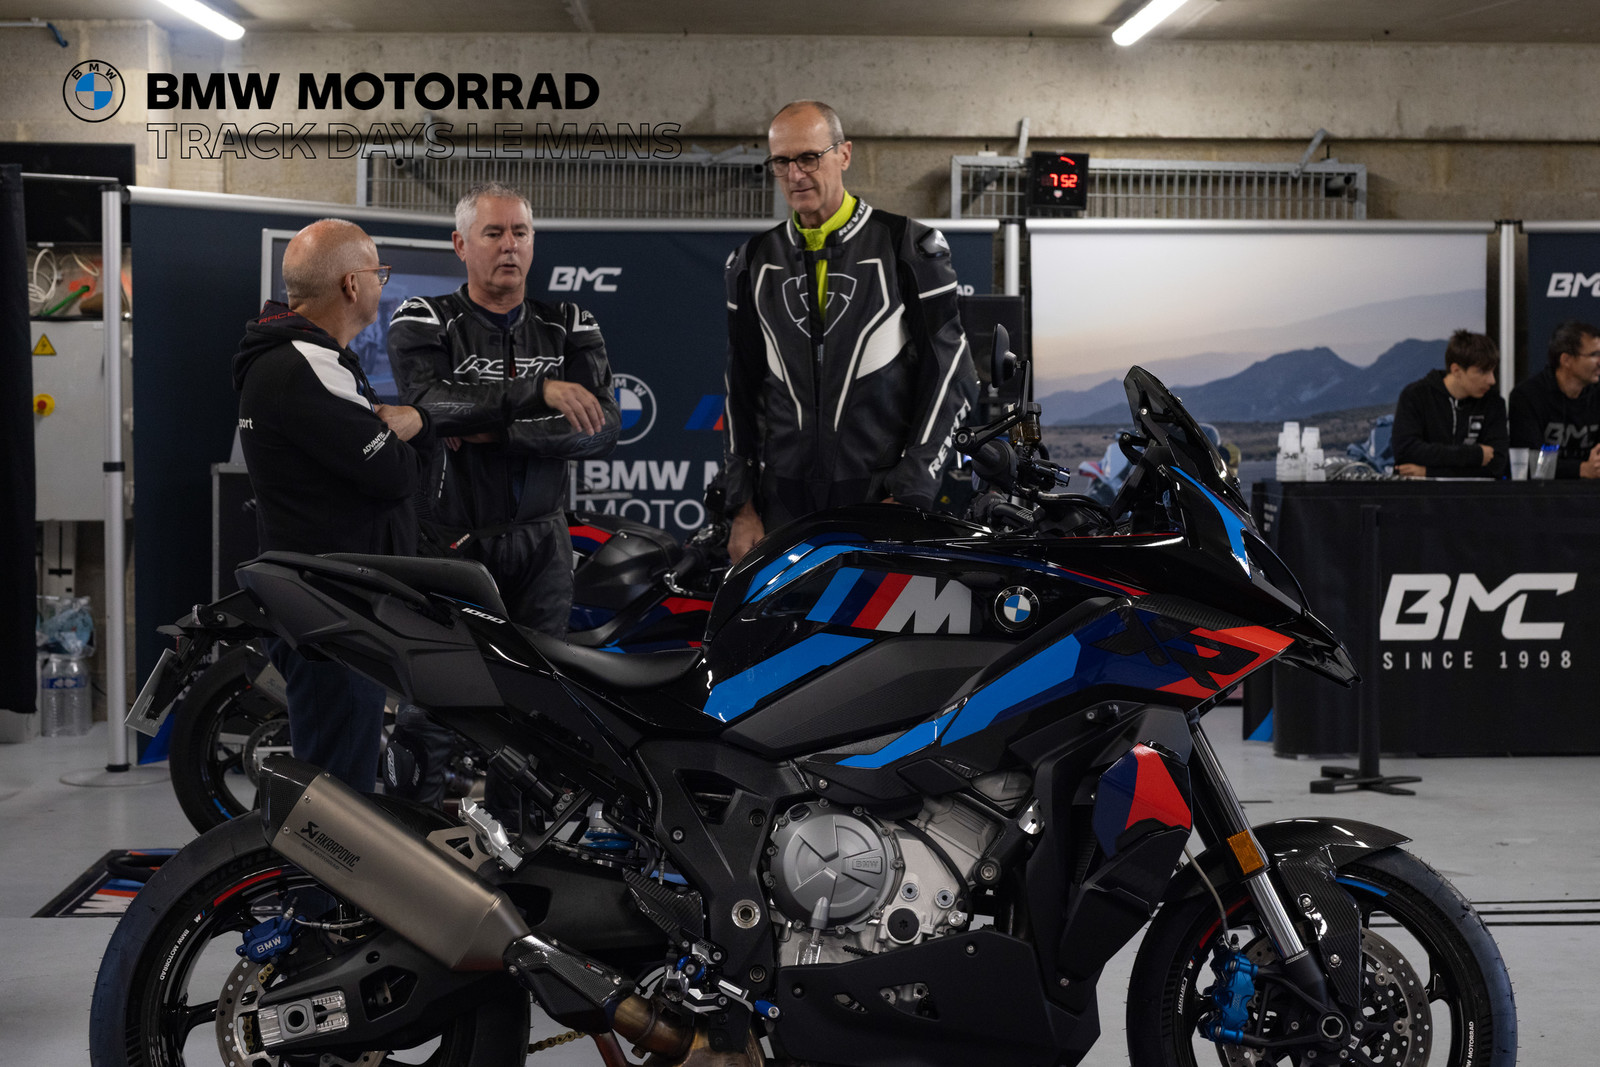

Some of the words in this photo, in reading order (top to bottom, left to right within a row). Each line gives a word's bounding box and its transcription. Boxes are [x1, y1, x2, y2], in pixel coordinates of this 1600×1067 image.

[548, 266, 622, 292] BMC
[584, 460, 691, 491] BMW
[461, 607, 507, 624] 1000
[1380, 572, 1578, 641] BMC
[1383, 651, 1474, 670] SINCE
[1500, 650, 1572, 669] 1998
[177, 929, 190, 946] BMW
[256, 936, 282, 954] BMW
[160, 945, 179, 981] MOTORRAD
[1467, 1021, 1475, 1059] MOTORRAD
